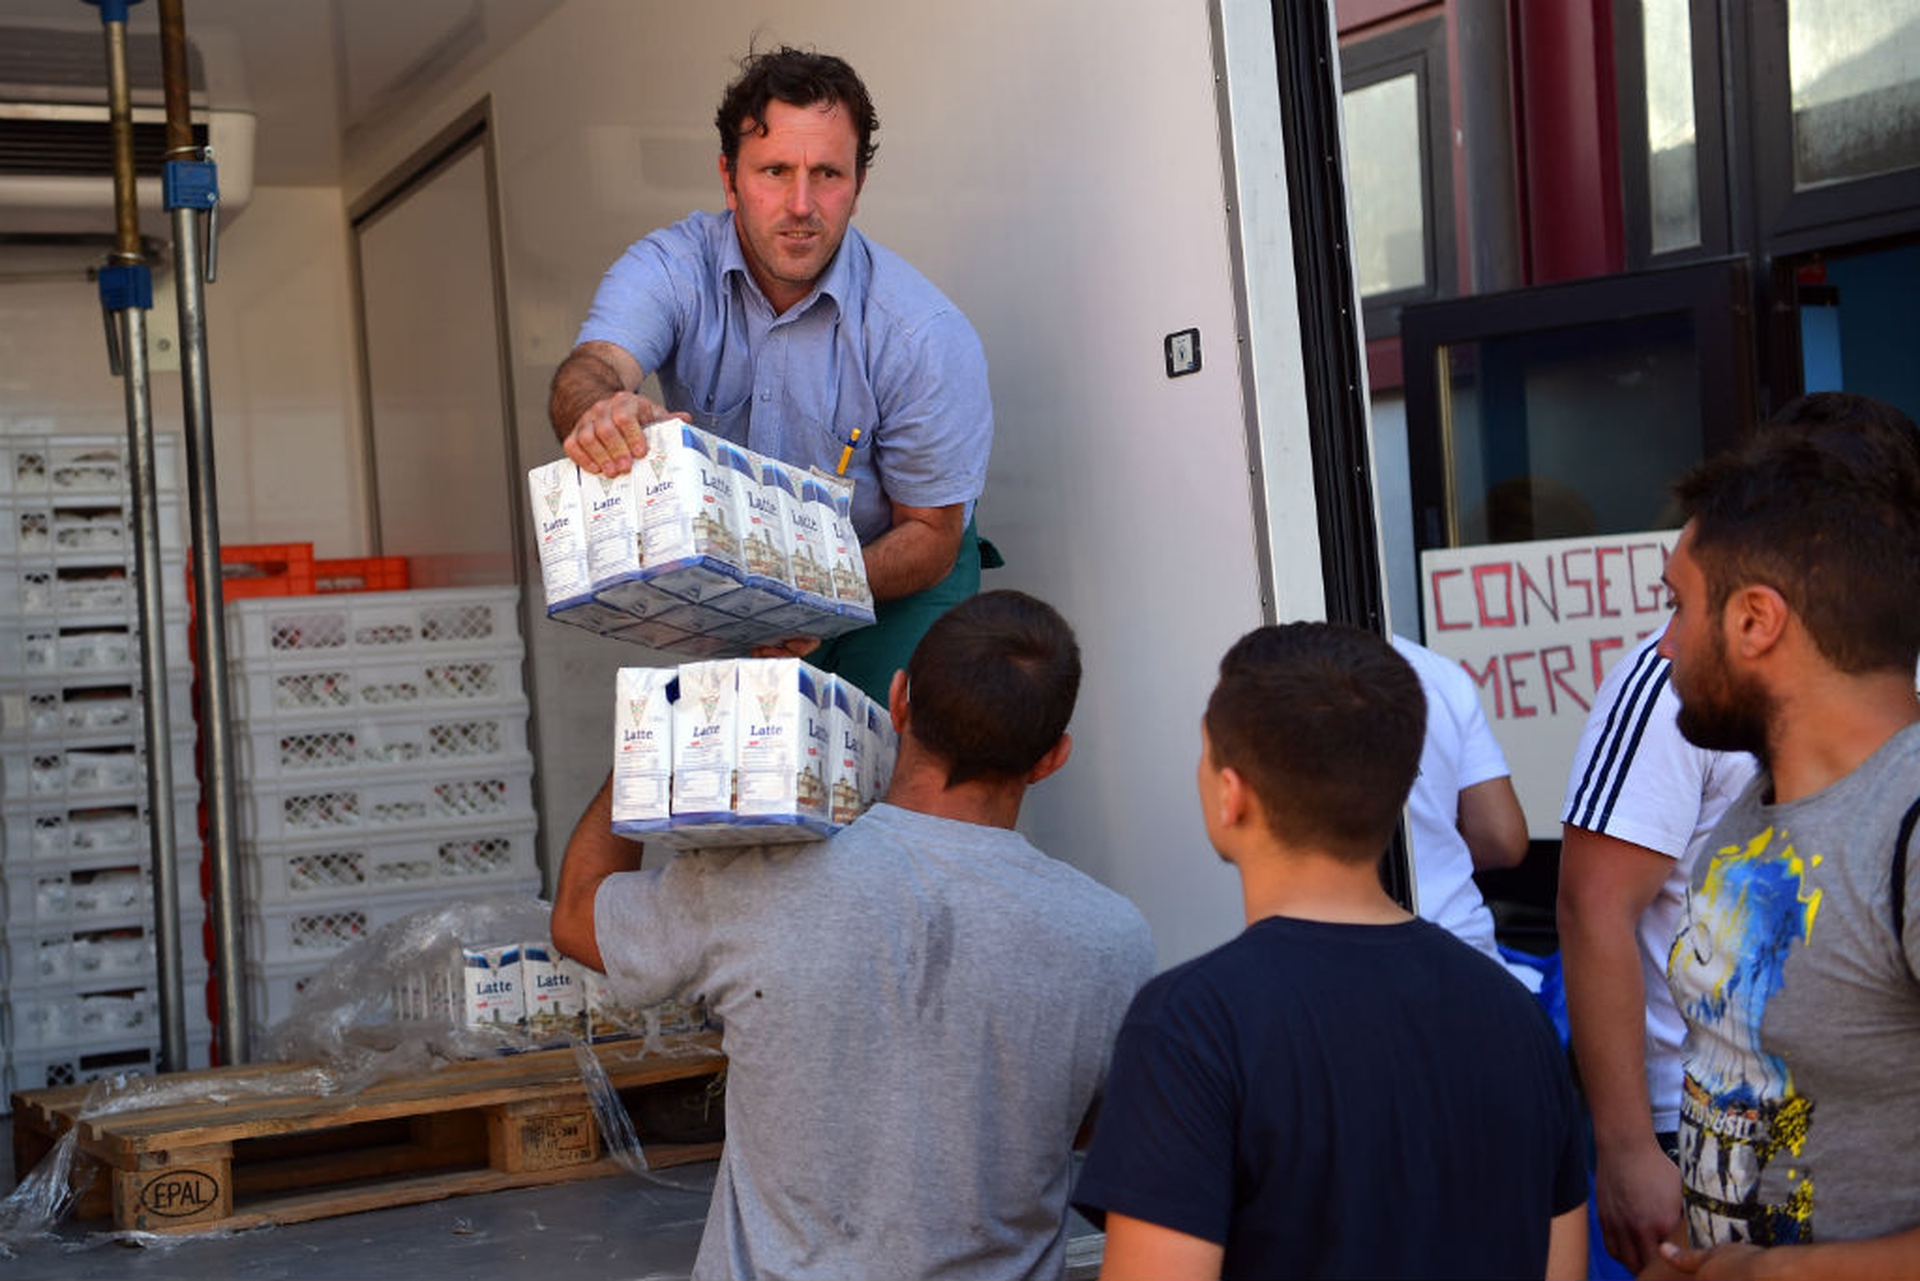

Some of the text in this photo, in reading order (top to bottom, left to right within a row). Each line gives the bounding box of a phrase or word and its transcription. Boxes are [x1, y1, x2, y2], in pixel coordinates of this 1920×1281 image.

[645, 480, 674, 496] Latte
[593, 495, 621, 512] Latte
[542, 517, 570, 534] Latte
[1460, 632, 1656, 720] MERC
[623, 729, 653, 742] Latte
[692, 724, 721, 738] Latte
[749, 724, 783, 737] Latte
[476, 981, 513, 995] Latte
[536, 974, 572, 989] Latte
[153, 1180, 208, 1208] EPAL
